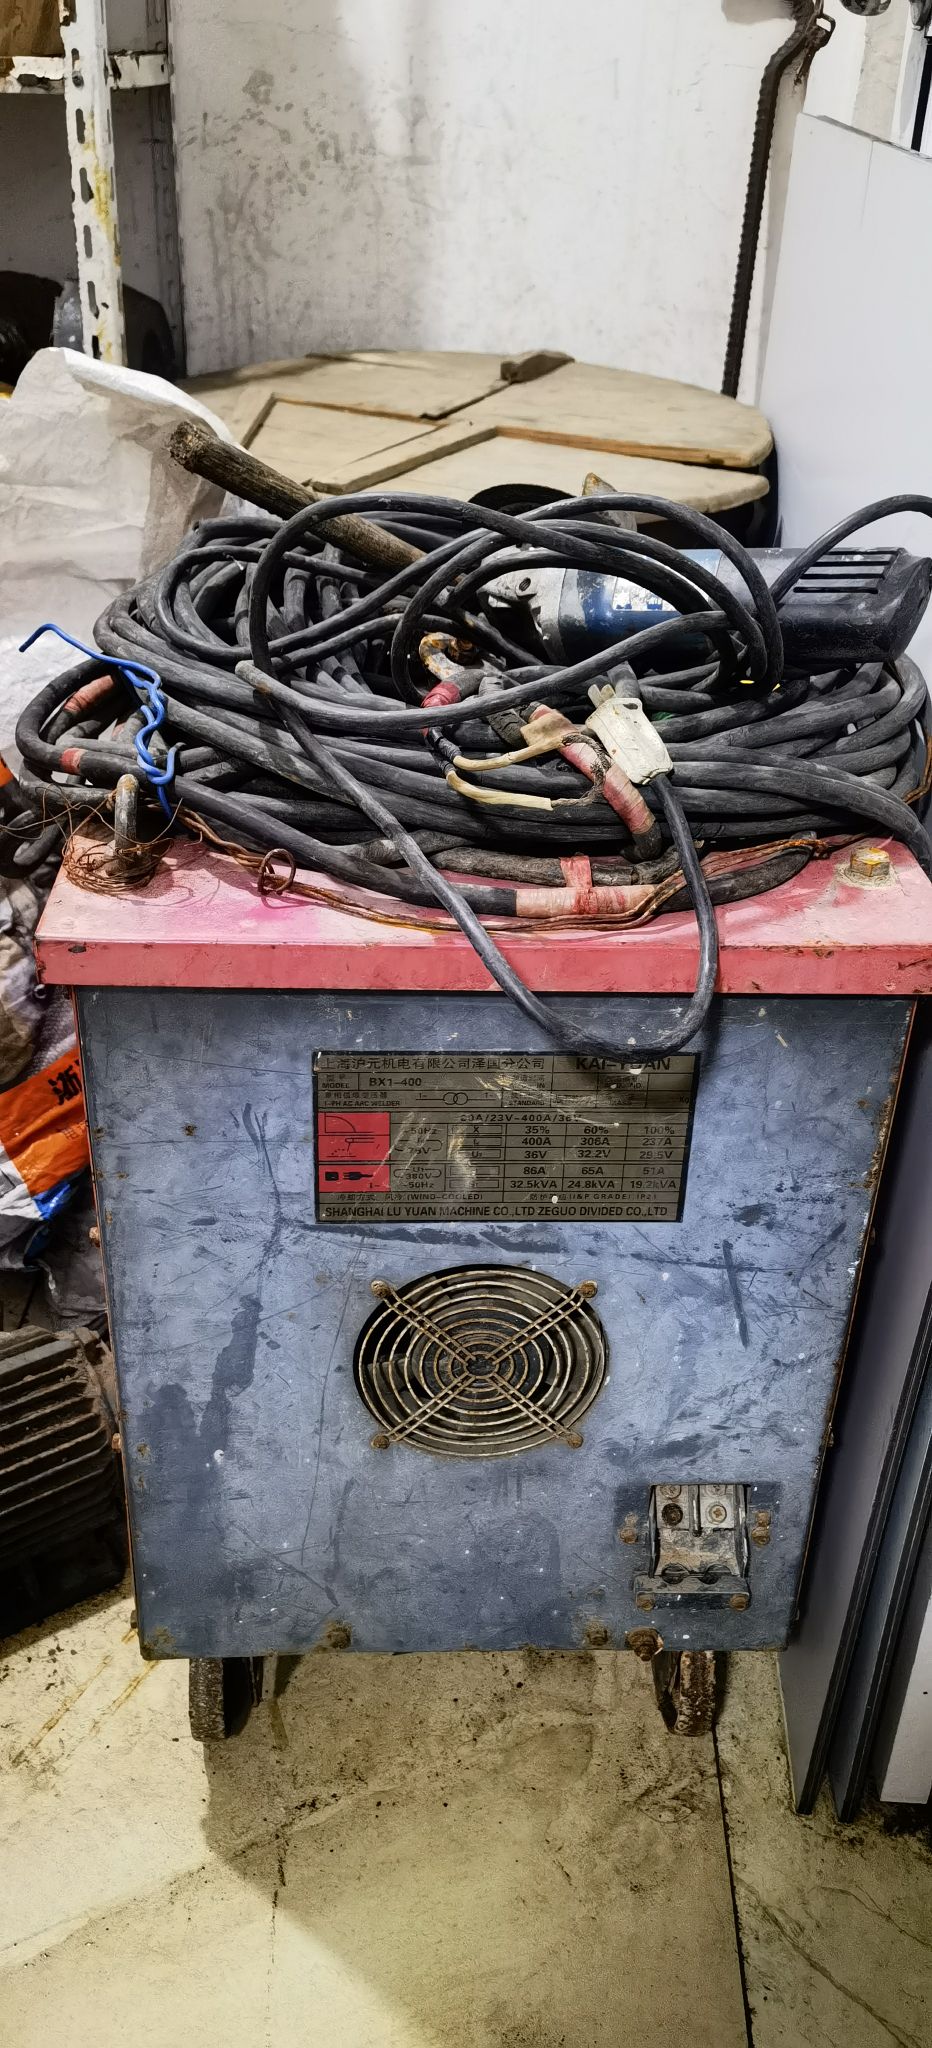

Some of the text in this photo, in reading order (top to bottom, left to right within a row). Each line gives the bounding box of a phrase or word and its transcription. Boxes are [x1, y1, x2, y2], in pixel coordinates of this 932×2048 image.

[321, 1057, 545, 1070] 上海沪元机电有限公司泽国分公司
[369, 1077, 422, 1087] BX1-400
[525, 1126, 550, 1134] 35%
[584, 1125, 609, 1134] 60%
[644, 1126, 675, 1134] 100%
[522, 1137, 552, 1146] 400A
[642, 1137, 673, 1146] 237A
[524, 1150, 548, 1159] 36V
[578, 1149, 612, 1158] 32.2V
[523, 1166, 546, 1175] 86A
[581, 1166, 604, 1175] 65A
[643, 1166, 665, 1175] 51A
[510, 1180, 557, 1189] 32.5kVA
[567, 1180, 615, 1189] 24.8kVA
[326, 1207, 384, 1217] SHANGHAI
[387, 1206, 401, 1216] LU
[405, 1206, 437, 1216] YUAN
[440, 1206, 490, 1216] MACHINE
[537, 1206, 577, 1216] ZEGUO
[579, 1206, 623, 1216] DIVIDED
